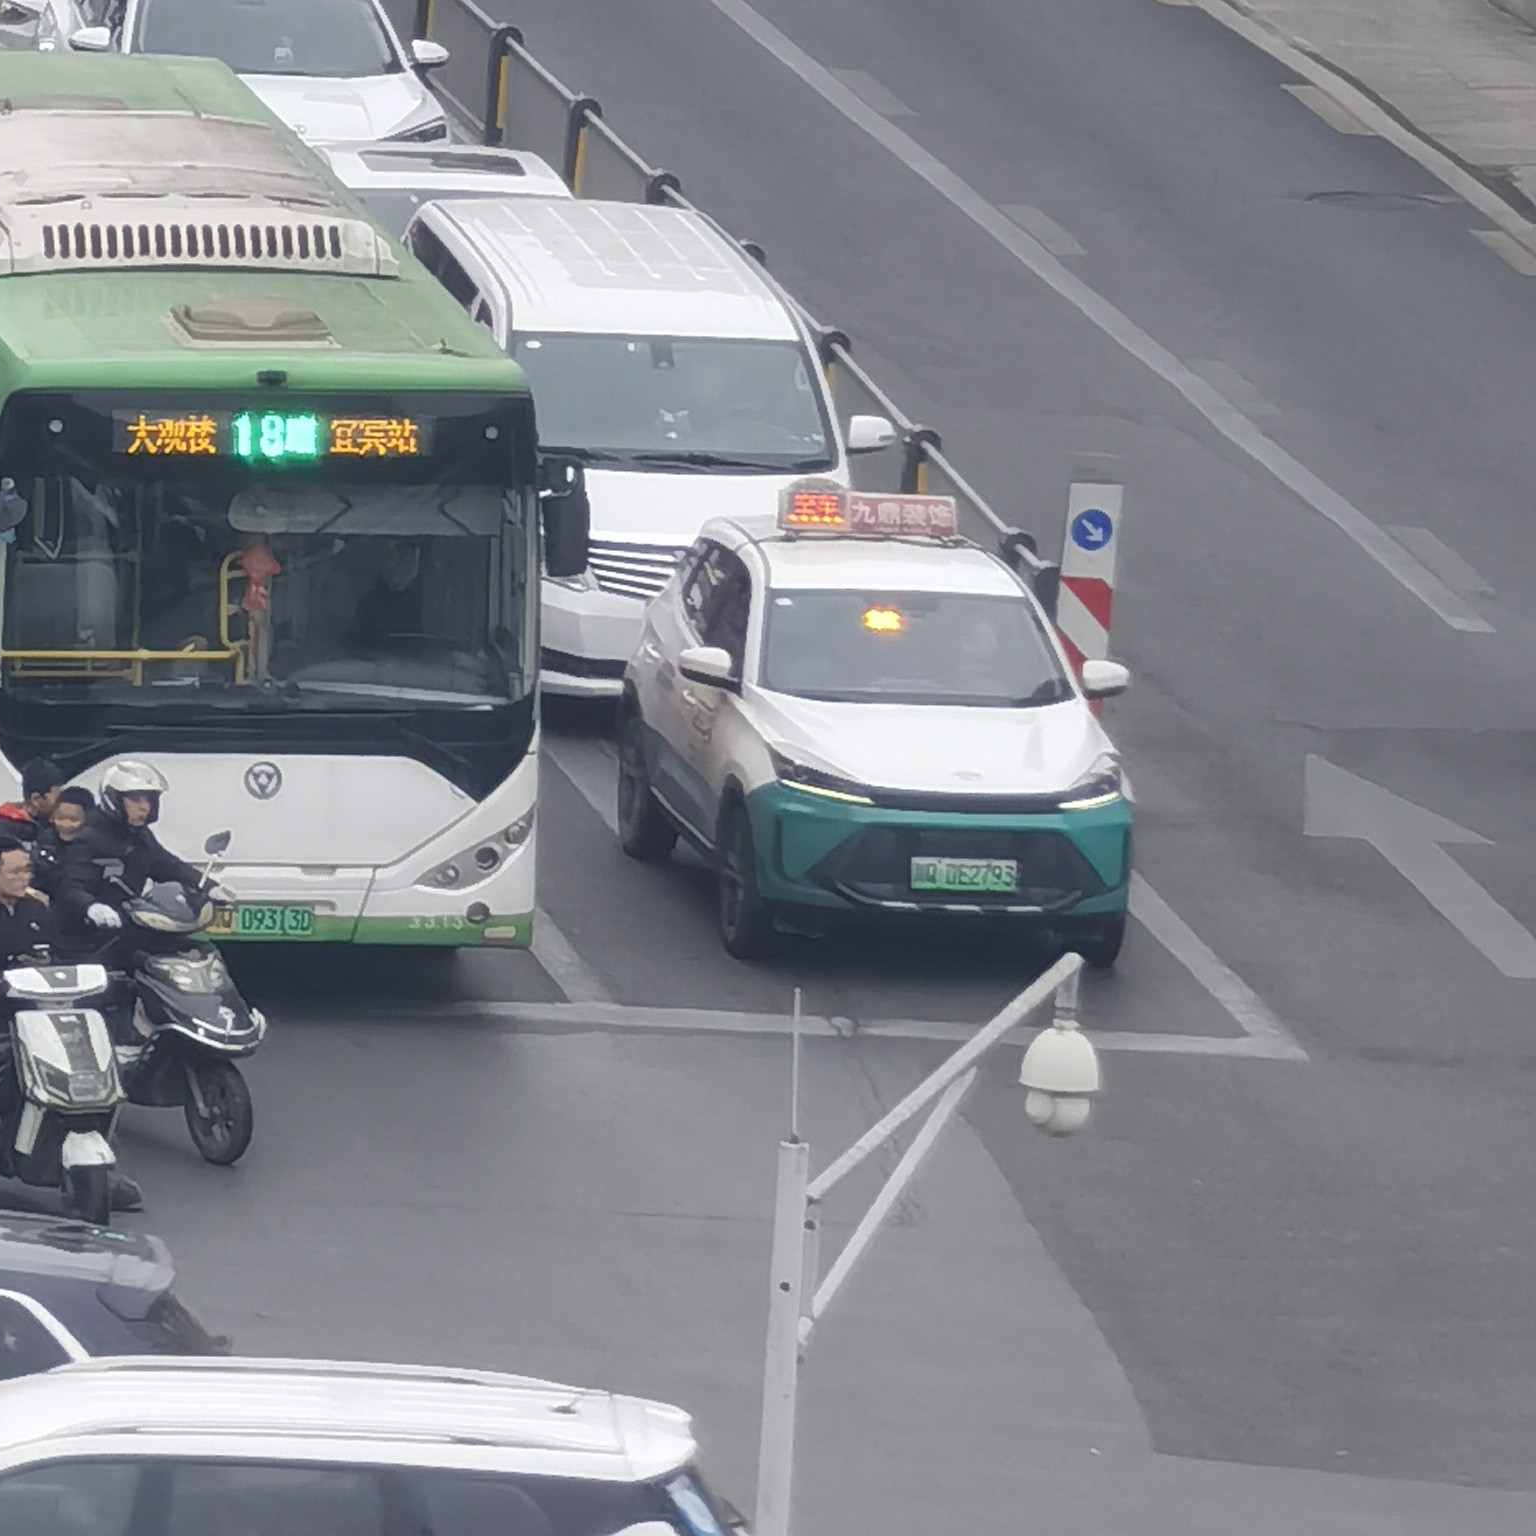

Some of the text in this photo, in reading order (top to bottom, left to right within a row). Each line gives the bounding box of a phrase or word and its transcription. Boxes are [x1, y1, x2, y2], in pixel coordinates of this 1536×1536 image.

[126, 411, 419, 457] 大观楼 18 宜宾站
[851, 501, 953, 528] 九鼎装饰
